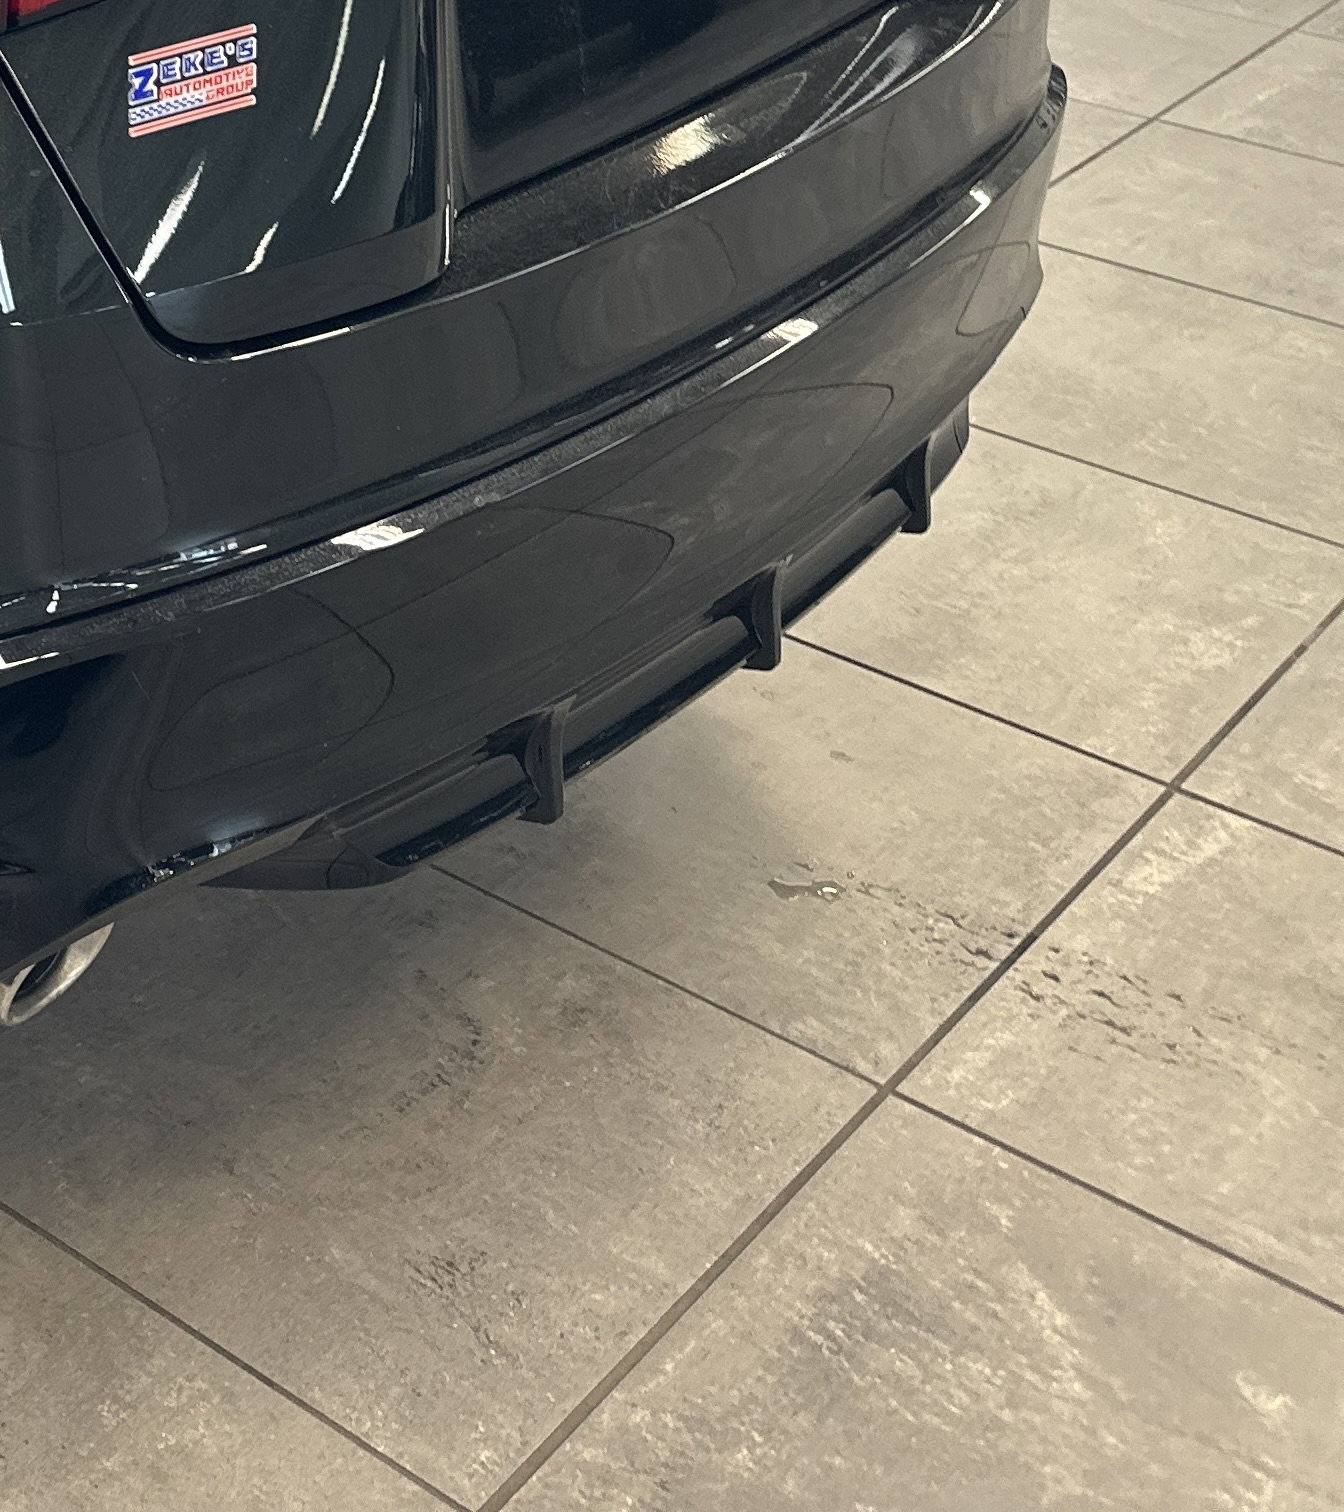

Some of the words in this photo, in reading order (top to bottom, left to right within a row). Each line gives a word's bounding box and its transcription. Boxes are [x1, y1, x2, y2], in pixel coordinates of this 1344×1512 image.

[128, 37, 257, 105] ZEKE'S
[160, 65, 255, 98] AUTOMOTIVE
[205, 78, 255, 101] GROUP
